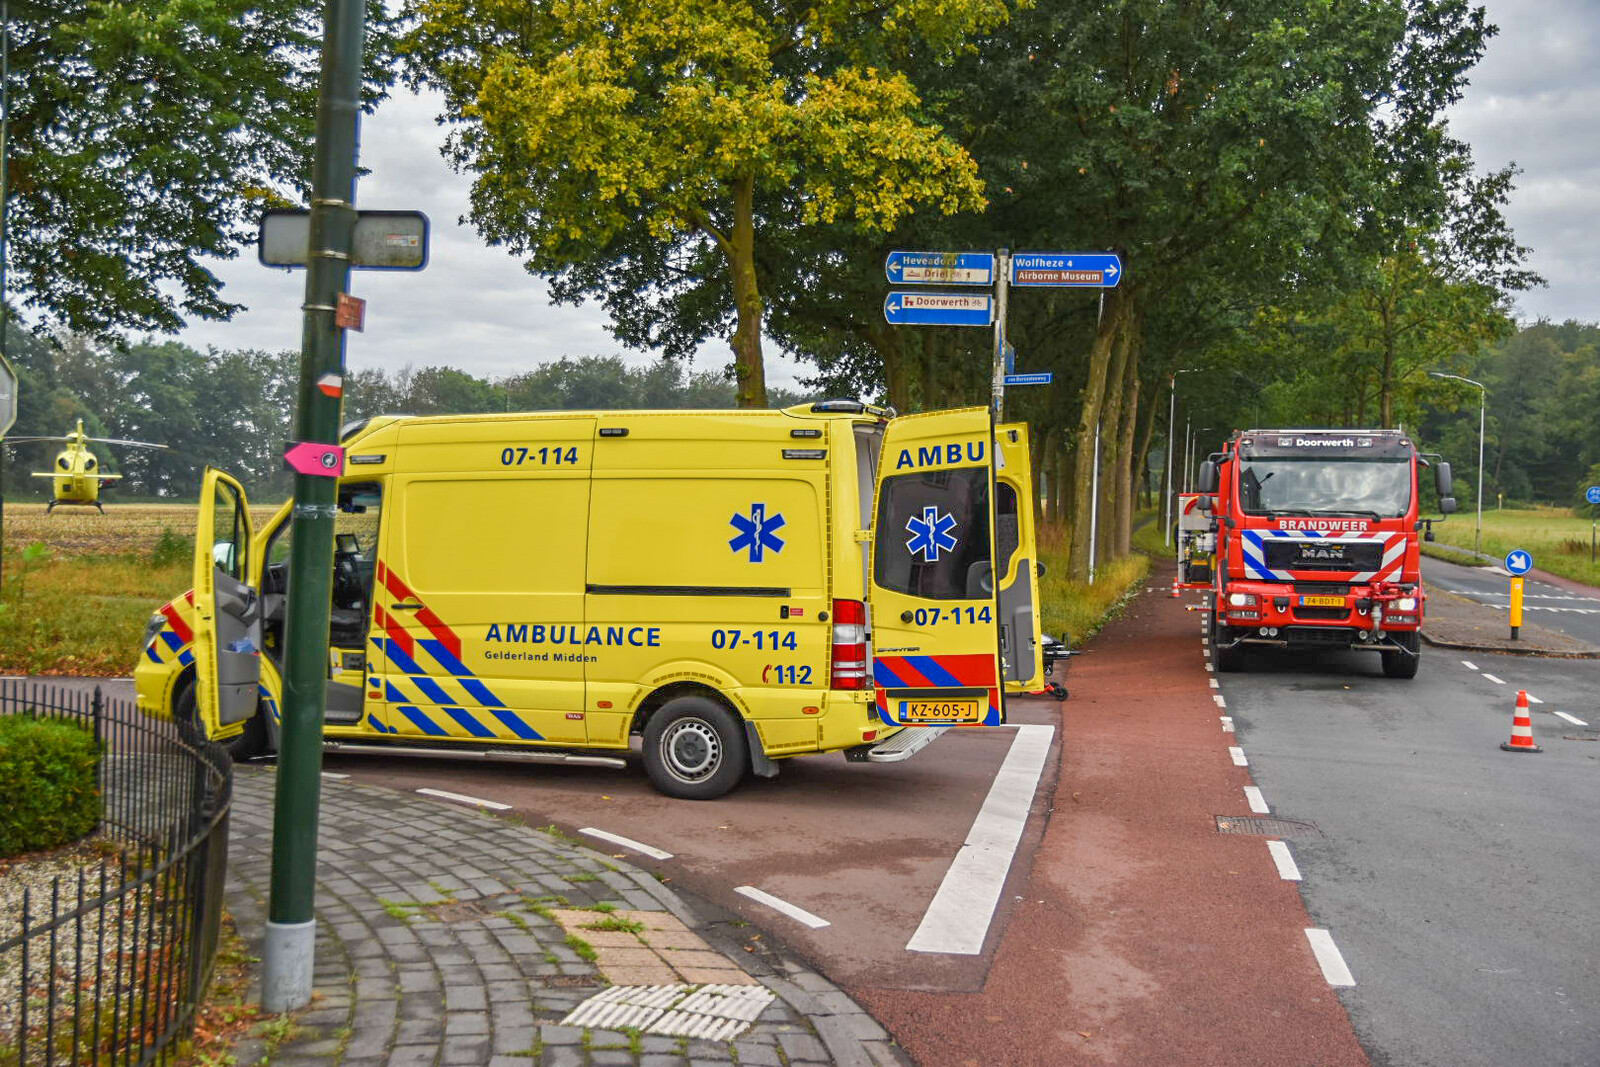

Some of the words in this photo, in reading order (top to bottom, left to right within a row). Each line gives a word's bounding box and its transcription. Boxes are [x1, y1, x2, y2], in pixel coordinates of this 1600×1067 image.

[1015, 258, 1064, 268] Wolfheze
[924, 269, 948, 279] Driel
[1018, 271, 1059, 281] Airborne
[1061, 273, 1100, 281] Museum
[916, 297, 969, 307] Doorwerth
[1296, 438, 1354, 447] Doorwerth
[501, 446, 578, 466] 07-114
[896, 441, 984, 469] AMBU
[1279, 521, 1368, 531] BRANDWEER
[1302, 549, 1343, 559] MAN
[915, 606, 992, 626] 07-114
[485, 624, 661, 647] AMBULANCE
[711, 629, 798, 651] 07-114
[484, 651, 549, 662] Gelderland
[553, 653, 598, 663] Midden
[911, 704, 972, 717] KZ-605-J
